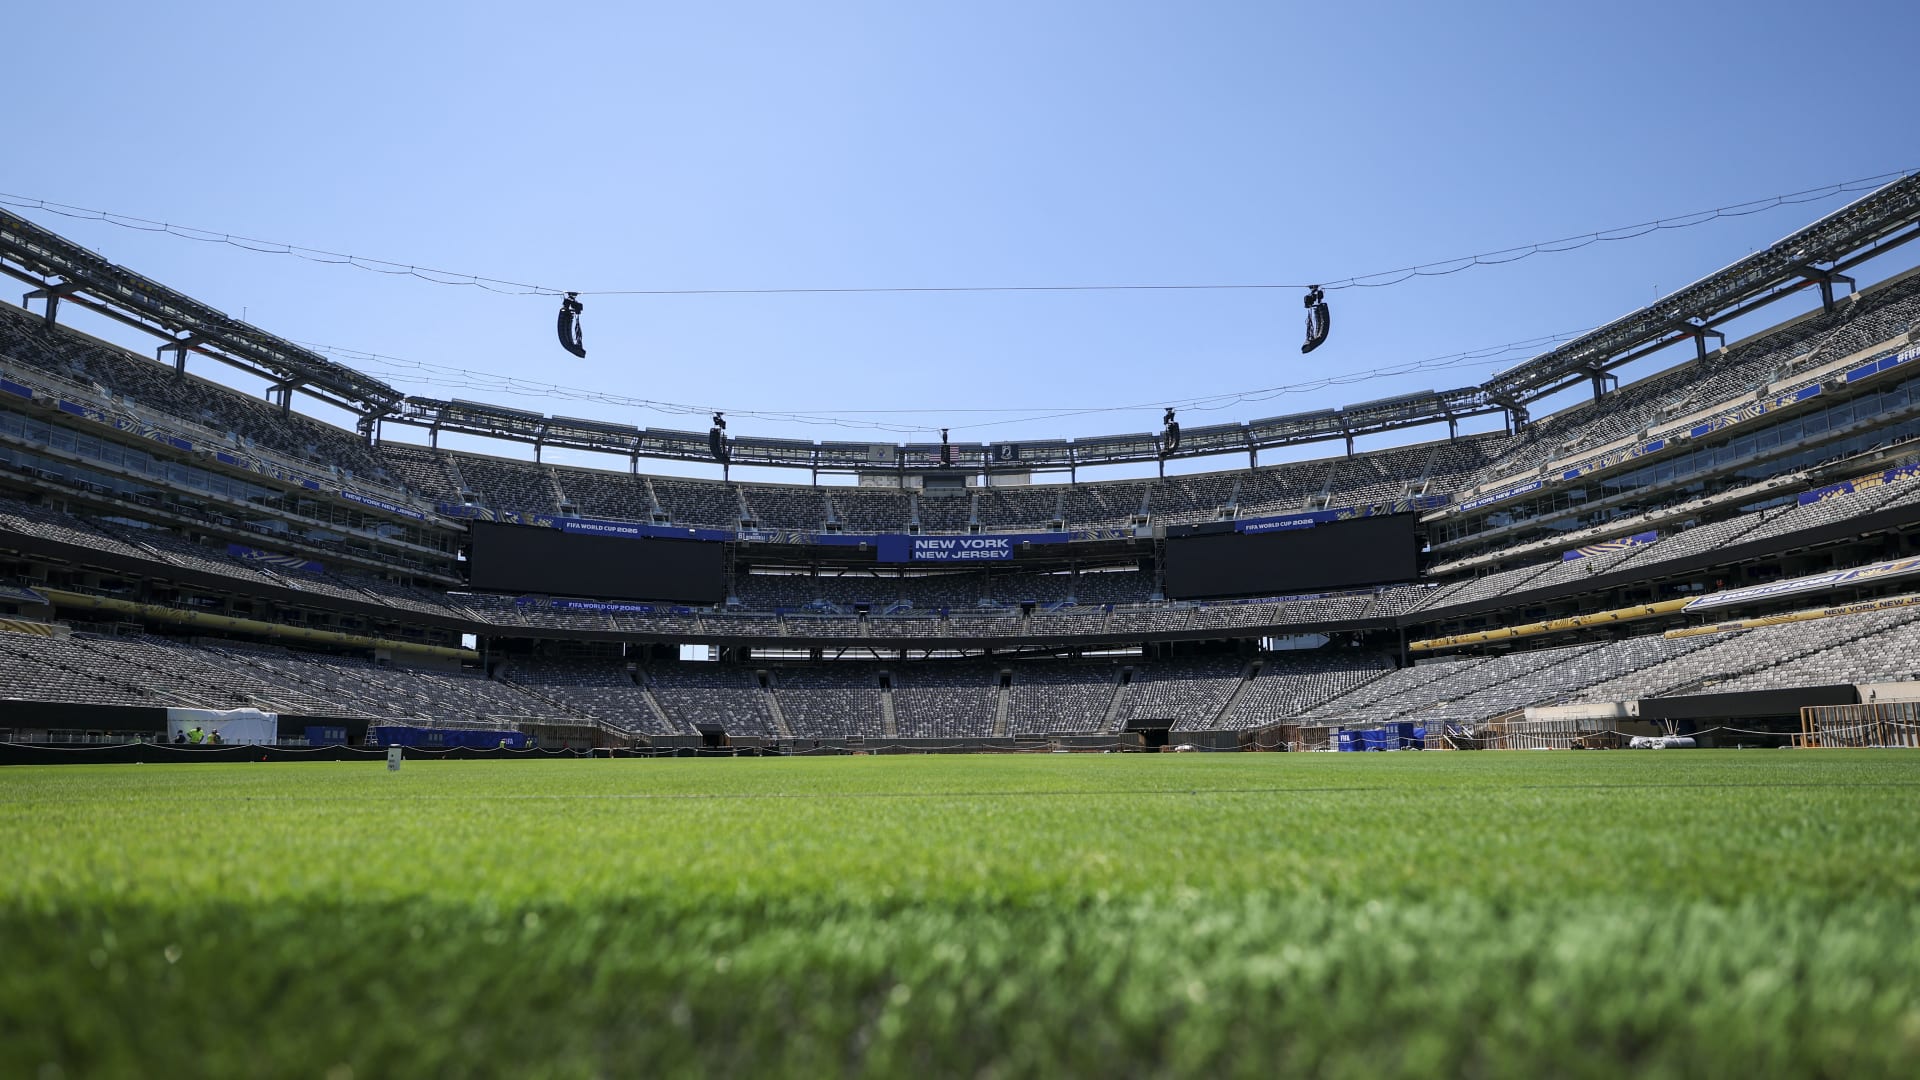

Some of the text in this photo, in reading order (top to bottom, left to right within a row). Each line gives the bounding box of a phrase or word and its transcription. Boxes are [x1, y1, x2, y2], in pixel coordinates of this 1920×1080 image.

[345, 493, 421, 518] NEW YORK NEW JERSEY
[1259, 522, 1280, 530] WORLD
[915, 538, 1009, 549] NEW YORK
[915, 550, 1009, 559] NEW JERSEY
[1824, 607, 1846, 616] NEW
[1849, 603, 1877, 612] YORK
[1880, 599, 1904, 608] NEW
